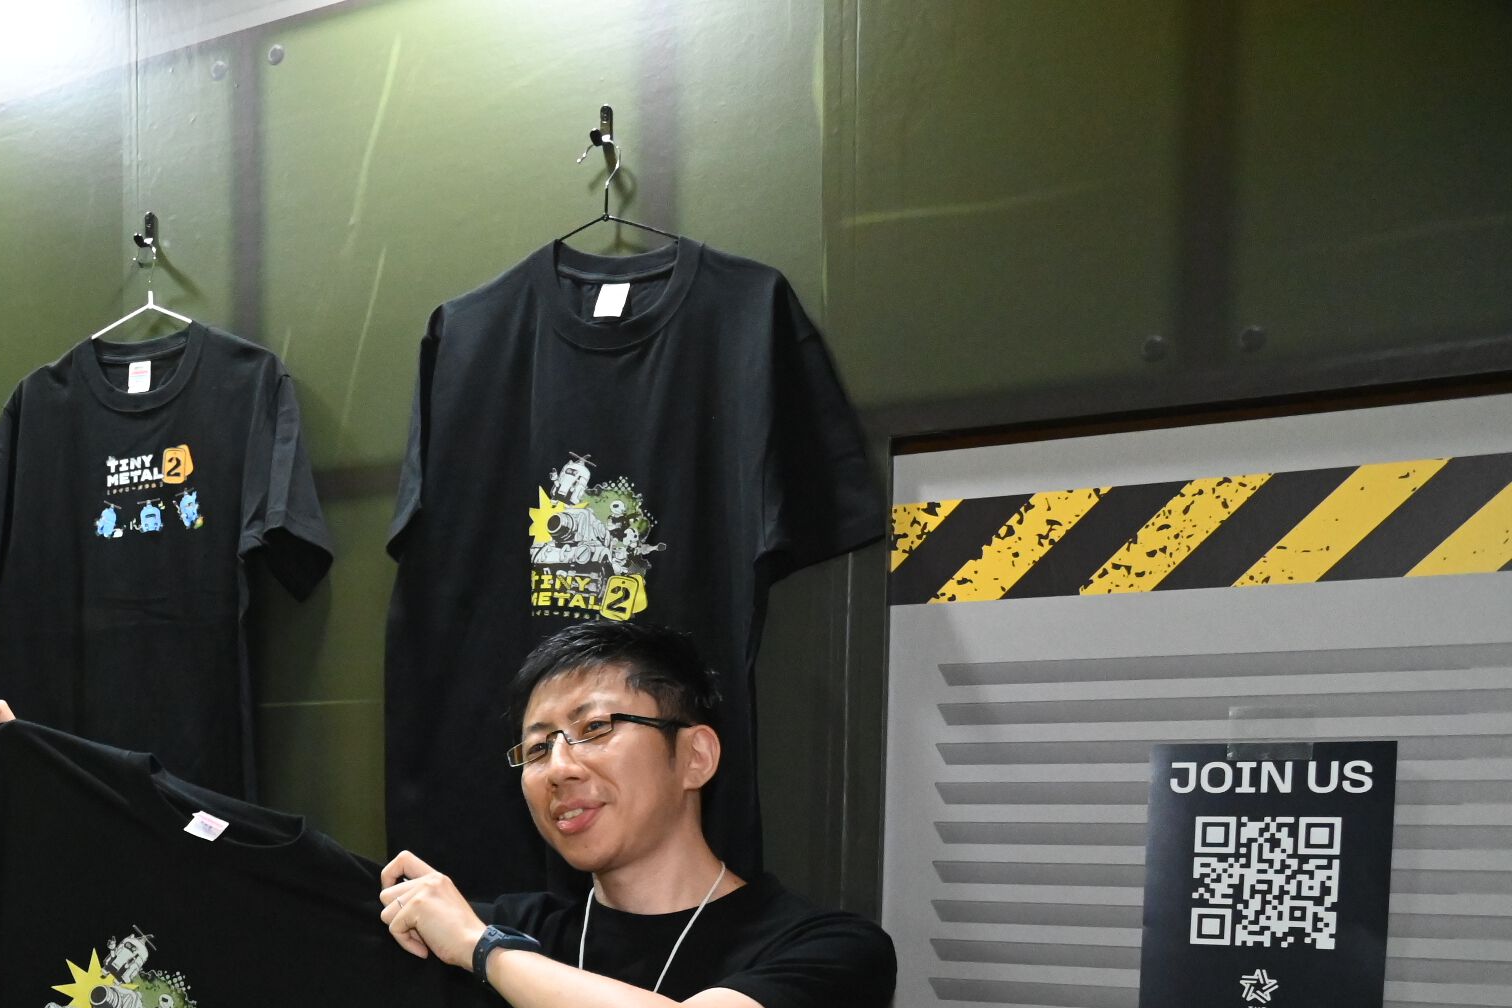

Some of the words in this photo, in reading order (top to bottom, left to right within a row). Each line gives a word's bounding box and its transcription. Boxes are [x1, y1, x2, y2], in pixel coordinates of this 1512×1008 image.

[106, 454, 153, 473] TINY
[107, 467, 164, 487] METAL
[167, 456, 181, 477] 2
[607, 585, 630, 614] 2
[1169, 761, 1293, 794] JOIN
[1306, 760, 1373, 794] US
